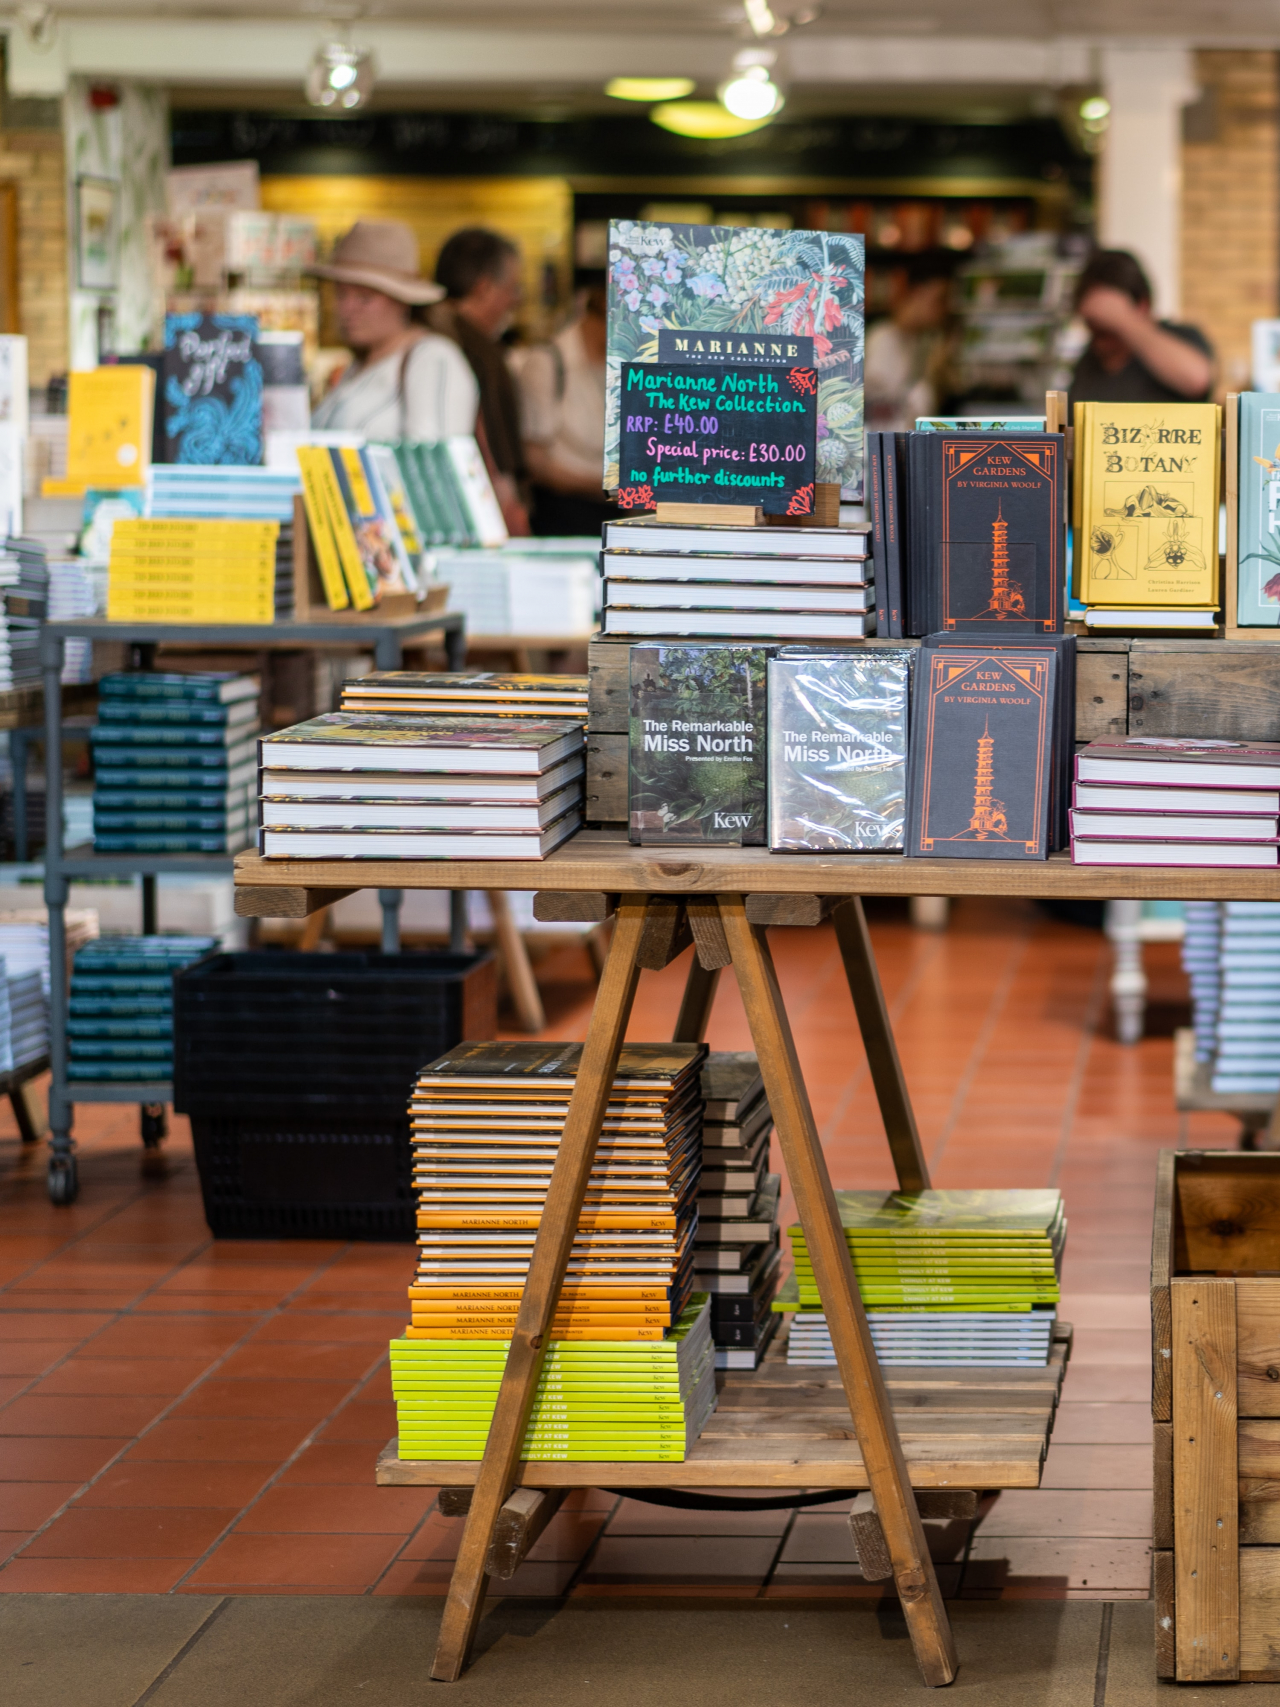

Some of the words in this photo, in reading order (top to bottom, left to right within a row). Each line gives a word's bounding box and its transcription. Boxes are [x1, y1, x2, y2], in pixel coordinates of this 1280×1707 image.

[675, 338, 798, 357] MARIANNE
[627, 368, 717, 392] Marianne
[721, 373, 779, 394] North
[645, 392, 675, 410] The
[679, 393, 710, 412] Kew
[715, 395, 806, 413] Collection
[626, 415, 658, 433] RRP:
[664, 413, 719, 435] £40.00
[646, 437, 699, 463] Special
[703, 445, 745, 465] price:
[749, 443, 806, 463] £30.00
[986, 456, 1013, 465] KEW
[1103, 450, 1198, 473] BOTANY
[630, 469, 647, 482] no
[653, 466, 711, 487] further
[713, 469, 785, 488] discounts
[973, 467, 1027, 476] GARDENS
[976, 671, 1003, 681] KEW
[961, 682, 1016, 692] GARDENS
[944, 695, 955, 703] BY
[957, 696, 998, 705] VIRGINIA
[999, 697, 1031, 705] WOOLF
[643, 719, 668, 732] The
[671, 719, 754, 732] Remarkable
[783, 730, 809, 743] The
[811, 730, 893, 743] Remarkable
[643, 735, 690, 752] Miss
[696, 735, 753, 752] North
[716, 755, 723, 763] by
[783, 745, 830, 763] Miss
[836, 746, 893, 763] North
[713, 812, 752, 829] Kew
[650, 1219, 667, 1227] Kew
[641, 1291, 658, 1299] Kew
[637, 1328, 654, 1337] Kew
